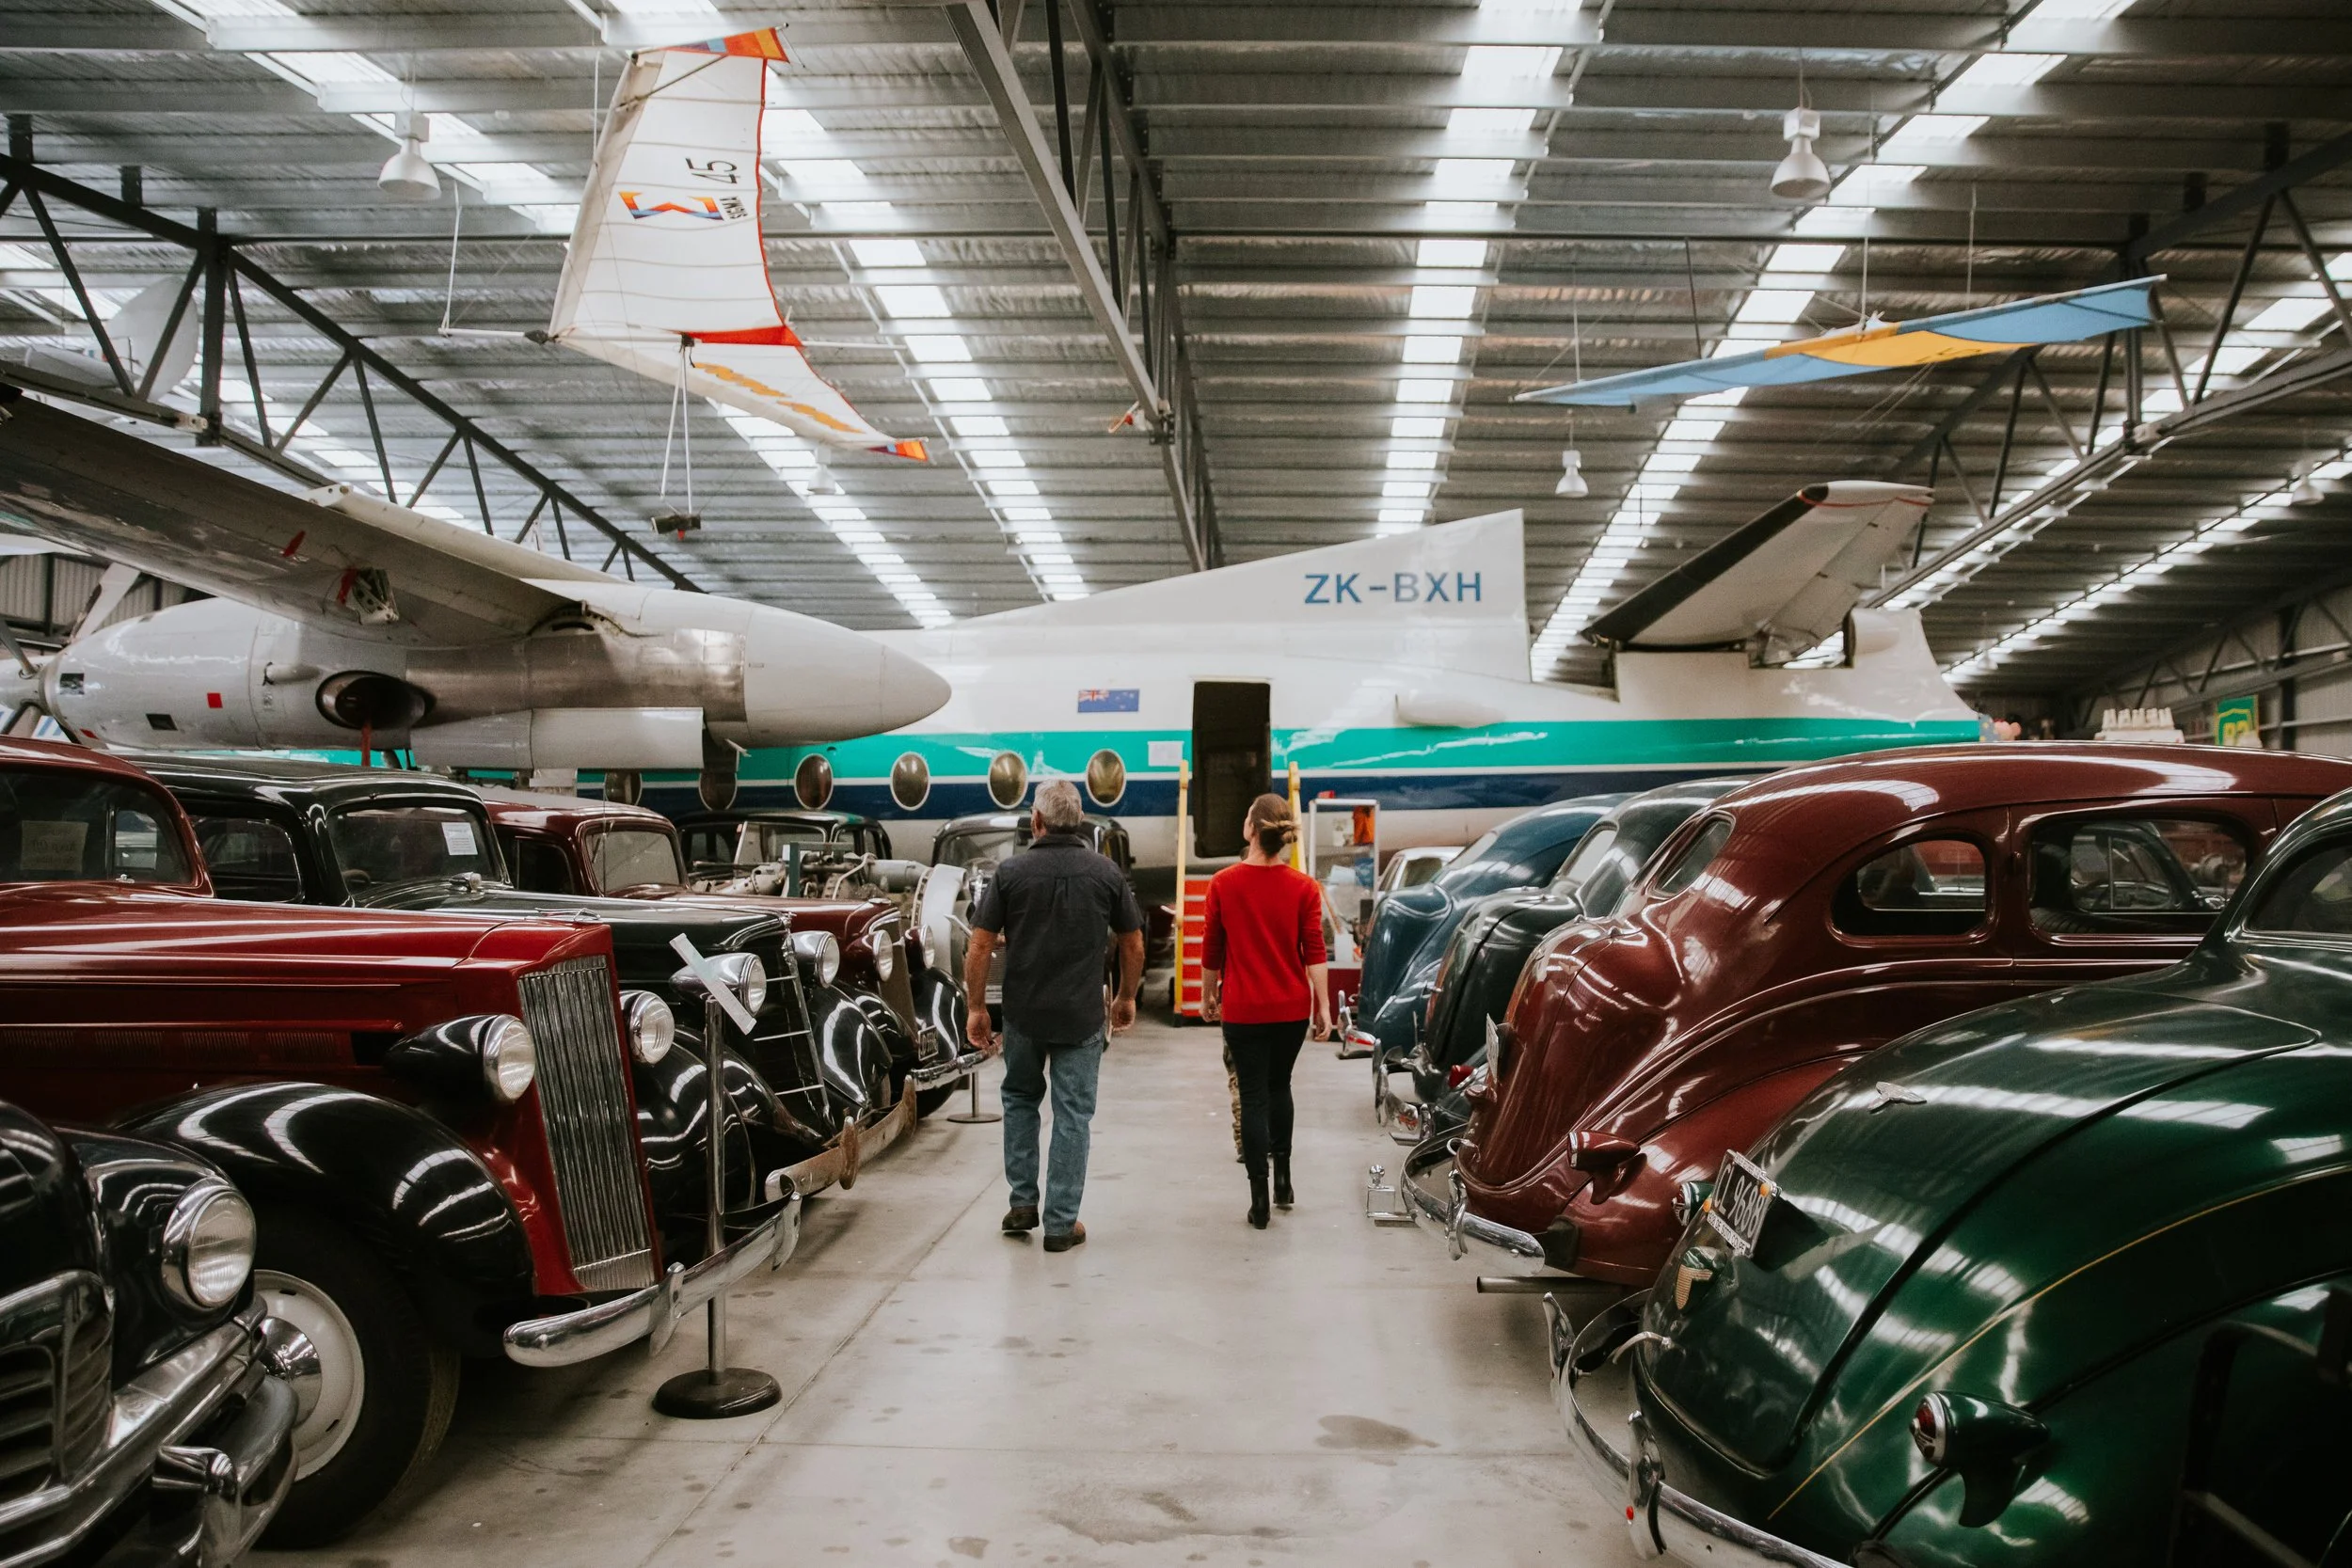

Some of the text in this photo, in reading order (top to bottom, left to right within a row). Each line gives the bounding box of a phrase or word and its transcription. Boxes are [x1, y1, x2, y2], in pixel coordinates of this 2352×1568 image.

[685, 157, 740, 183] 45
[1305, 572, 1481, 604] ZK-BXH
[1714, 1163, 1735, 1215] CL
[1727, 1175, 1766, 1239] 9688
